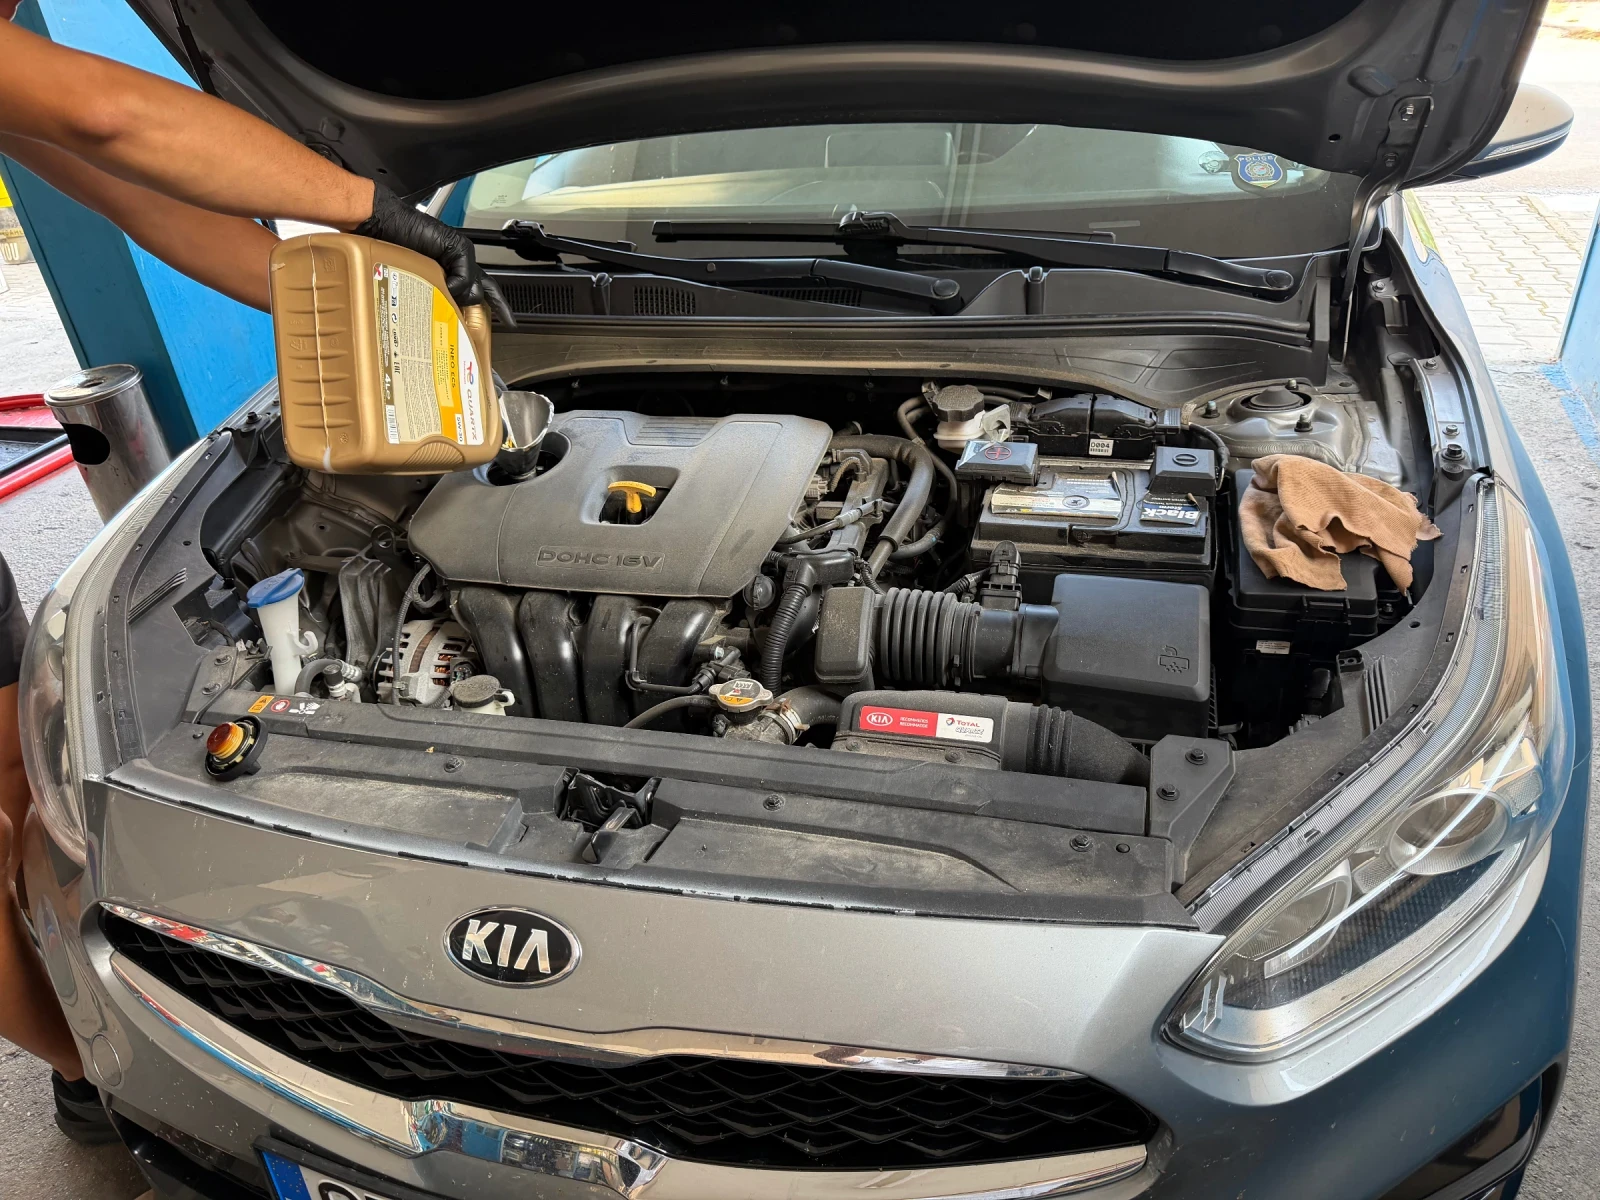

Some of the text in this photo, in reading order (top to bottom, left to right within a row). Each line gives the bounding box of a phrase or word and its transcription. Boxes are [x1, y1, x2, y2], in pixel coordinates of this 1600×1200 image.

[1142, 507, 1200, 519] Black
[537, 551, 663, 569] DOHC 16V
[870, 714, 889, 724] KIA
[956, 719, 980, 728] TOTAL
[462, 919, 551, 974] KIA
